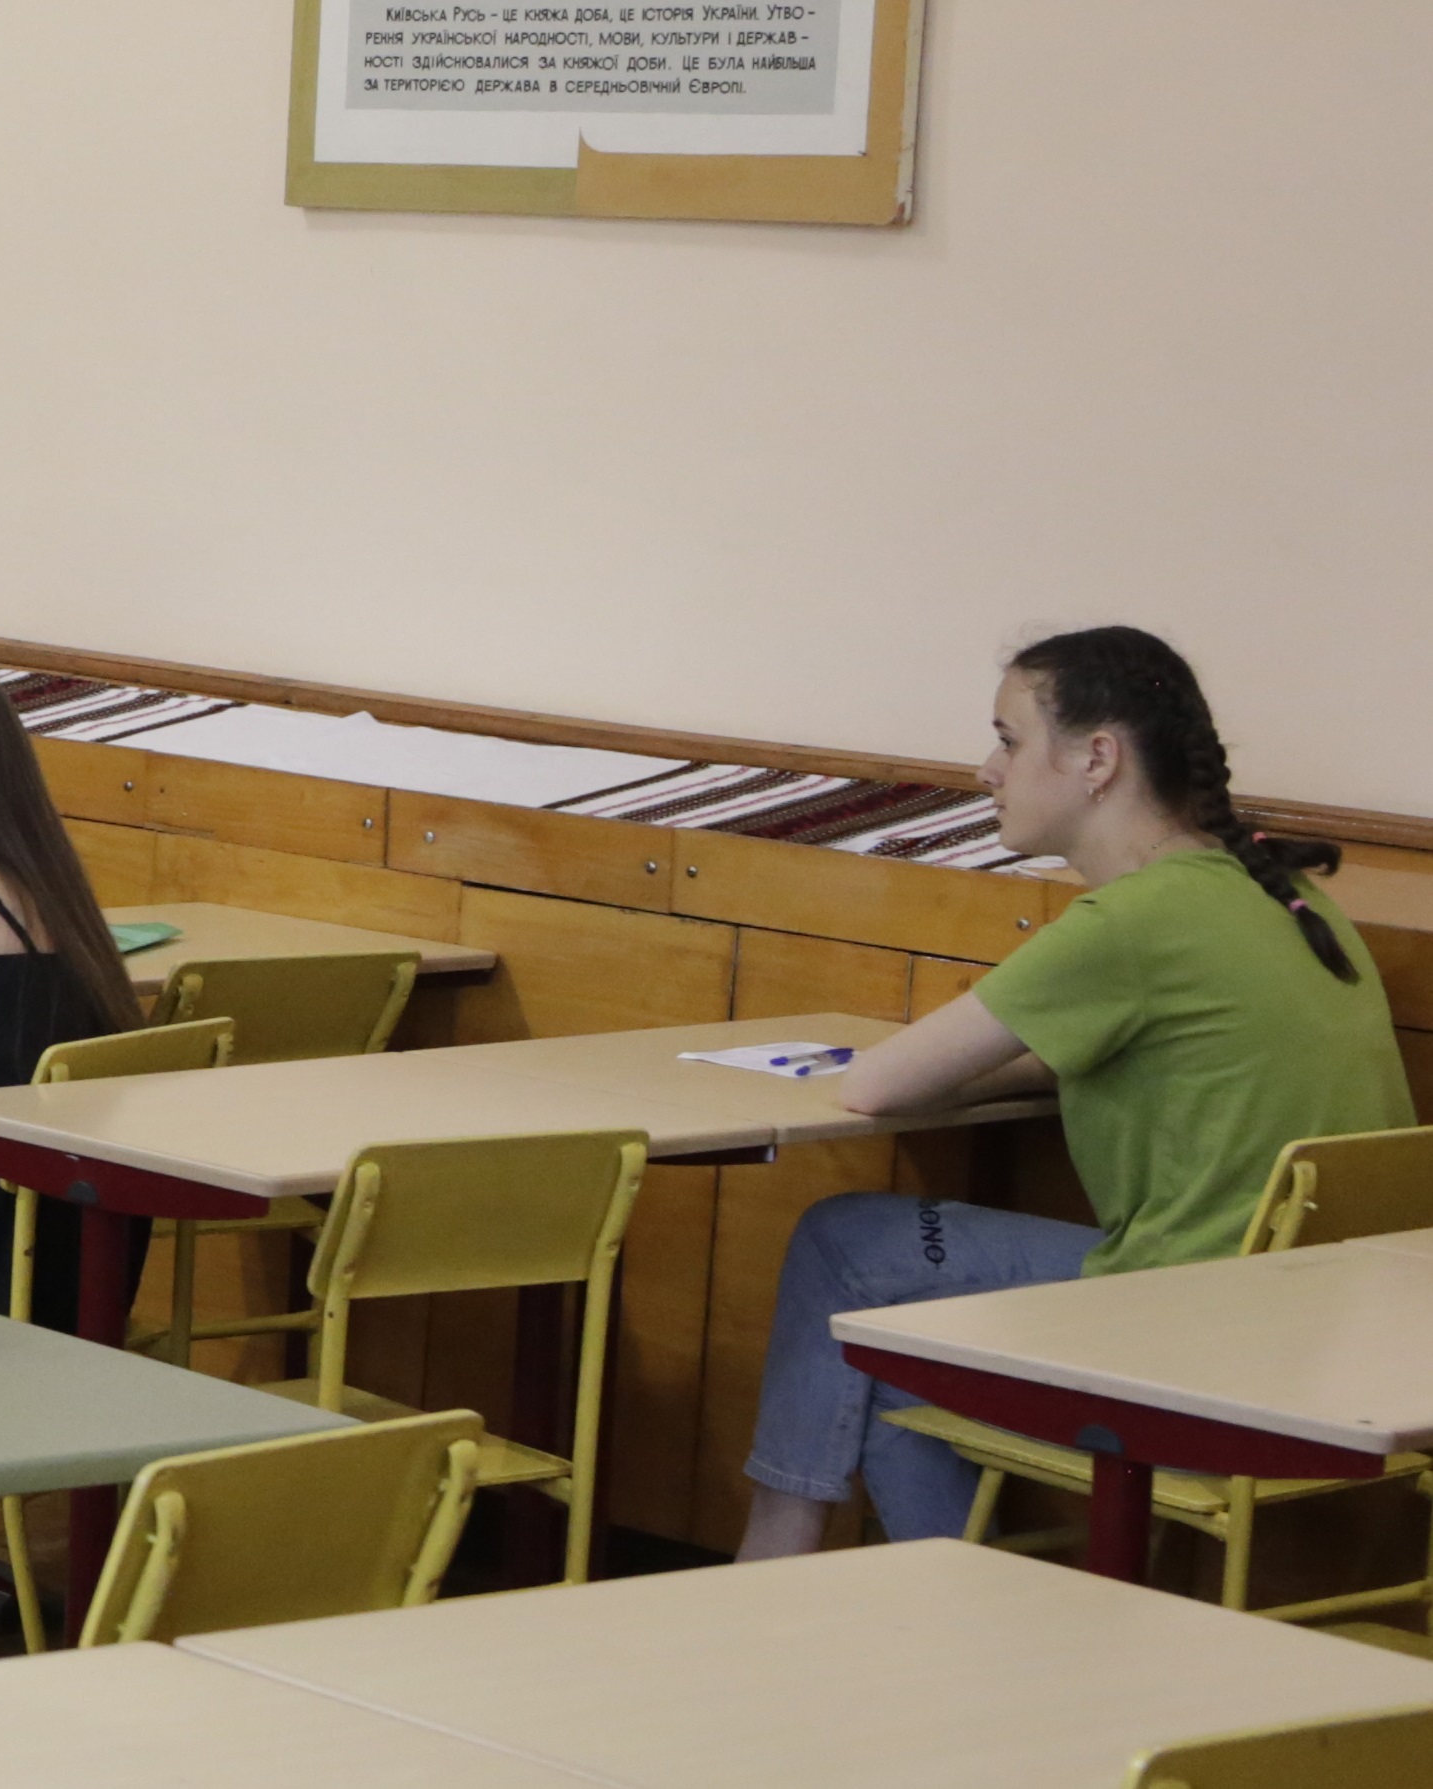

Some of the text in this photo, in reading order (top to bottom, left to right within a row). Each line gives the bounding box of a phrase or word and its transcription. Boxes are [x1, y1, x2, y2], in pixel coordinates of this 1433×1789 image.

[386, 6, 448, 22] КИЇВСЬКА
[452, 5, 486, 23] РУСЬ
[502, 8, 518, 24] ЦЕ
[524, 8, 569, 22] КНЯЖА
[573, 7, 613, 25] ДОБА,
[619, 7, 635, 24] ЦЕ
[365, 31, 404, 45] РЕННЯ
[411, 29, 497, 46] УКРАЇНСЬКОЇ
[504, 31, 593, 47] НАРОДНОСТІ,
[598, 31, 644, 48] МОВИ,
[651, 31, 720, 46] КУЛЬТУРИ
[364, 55, 404, 69] НОСТІ
[412, 53, 529, 71] ЗДІЙСНЮВАЛИСЯ
[538, 56, 557, 70] ЗА
[562, 54, 619, 72] КНЯЖОЇ
[626, 56, 672, 73] ДОБИ.
[682, 55, 700, 73] ЦЕ
[707, 56, 745, 71] БУЛА
[363, 77, 746, 96] ЗА ТЕРИТОРІЄЮ ДЕРЖАВА В СЕРЕДНЬОВІЧНІЙ ЄВРОПІ.
